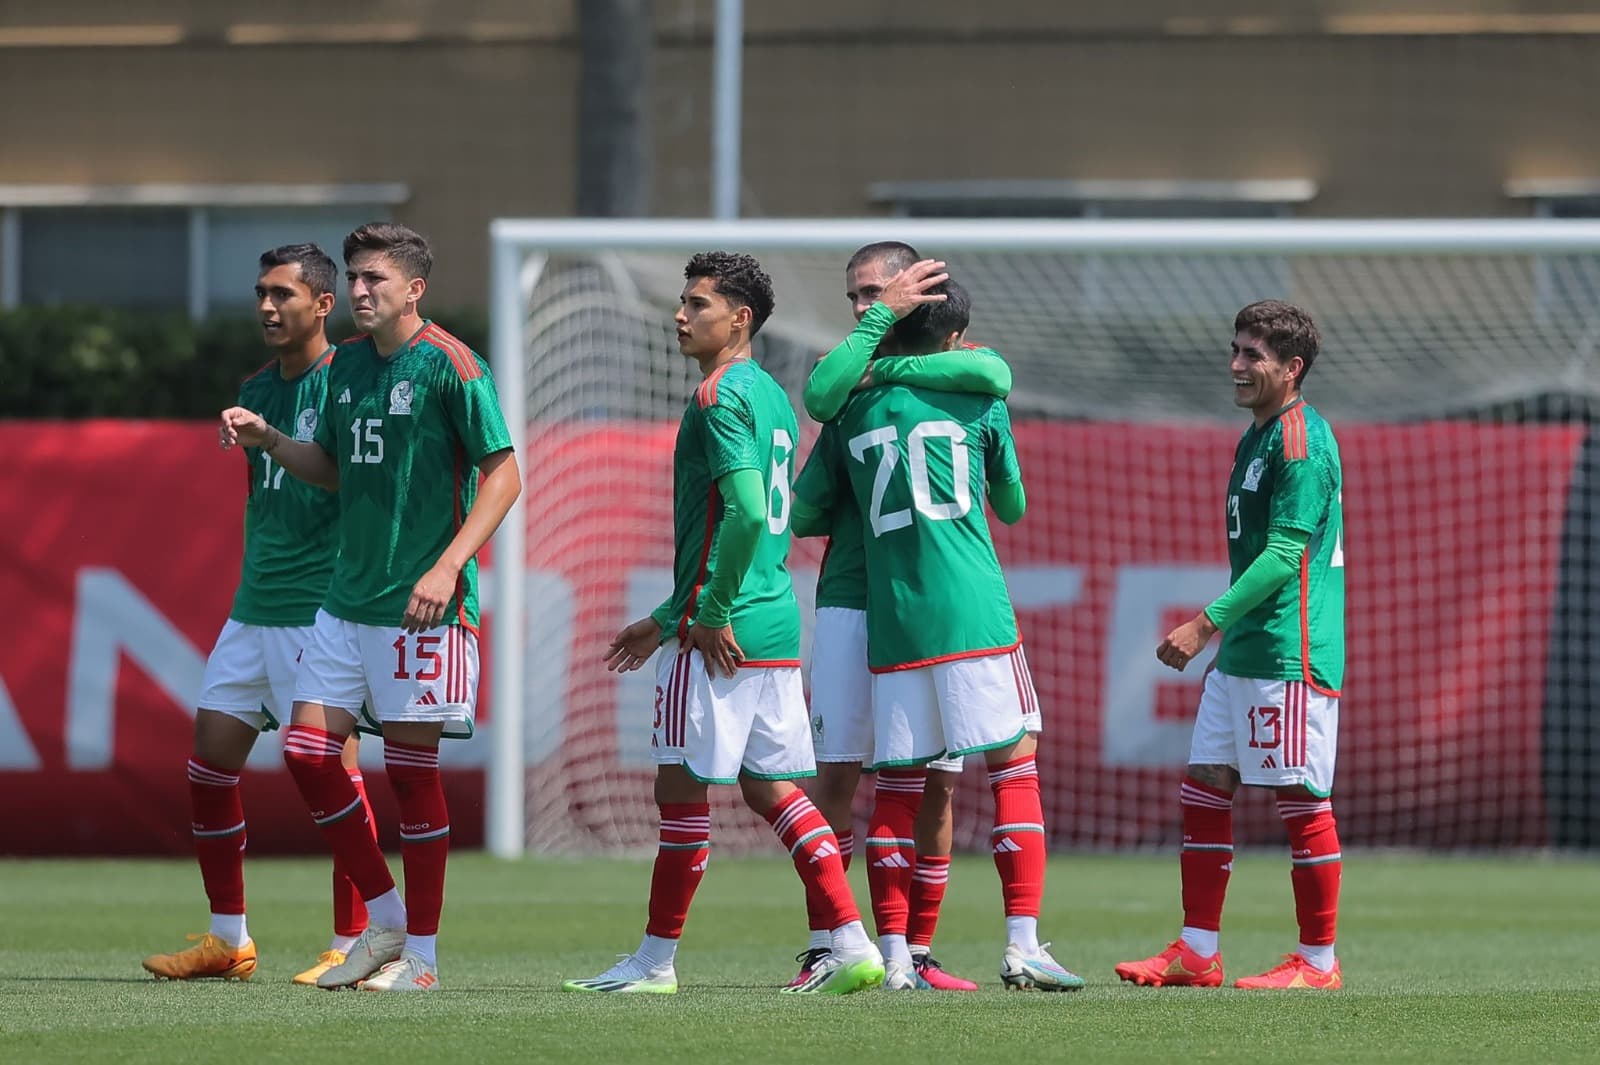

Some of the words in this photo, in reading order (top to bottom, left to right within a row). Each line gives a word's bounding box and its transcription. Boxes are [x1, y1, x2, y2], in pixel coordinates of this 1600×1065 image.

[350, 418, 384, 463] 15
[767, 428, 793, 535] 8
[849, 420, 972, 538] 20
[392, 635, 442, 681] 15
[1247, 706, 1281, 749] 13
